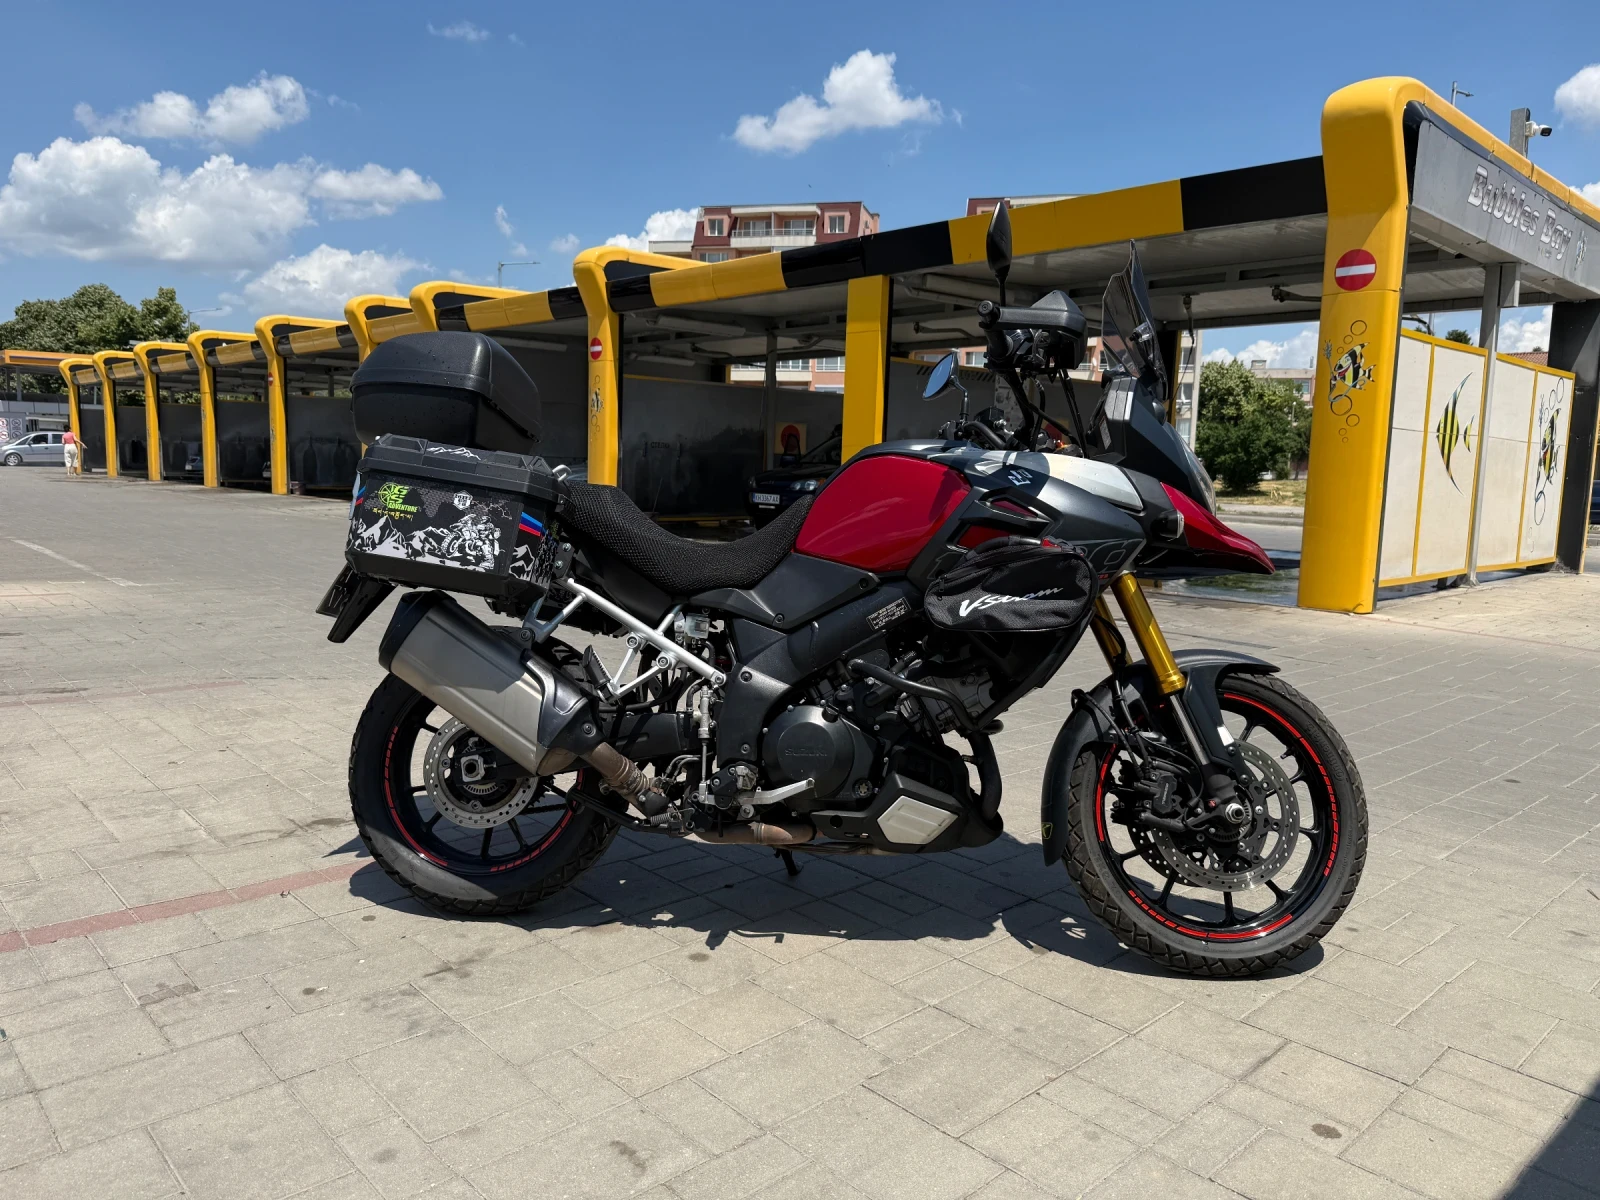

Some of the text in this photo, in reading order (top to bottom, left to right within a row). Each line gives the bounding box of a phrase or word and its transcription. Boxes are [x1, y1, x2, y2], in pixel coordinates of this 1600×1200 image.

[1467, 164, 1573, 260] Bubbles Bay
[387, 503, 418, 513] ADVENTURE
[784, 747, 828, 757] SUZUKI
